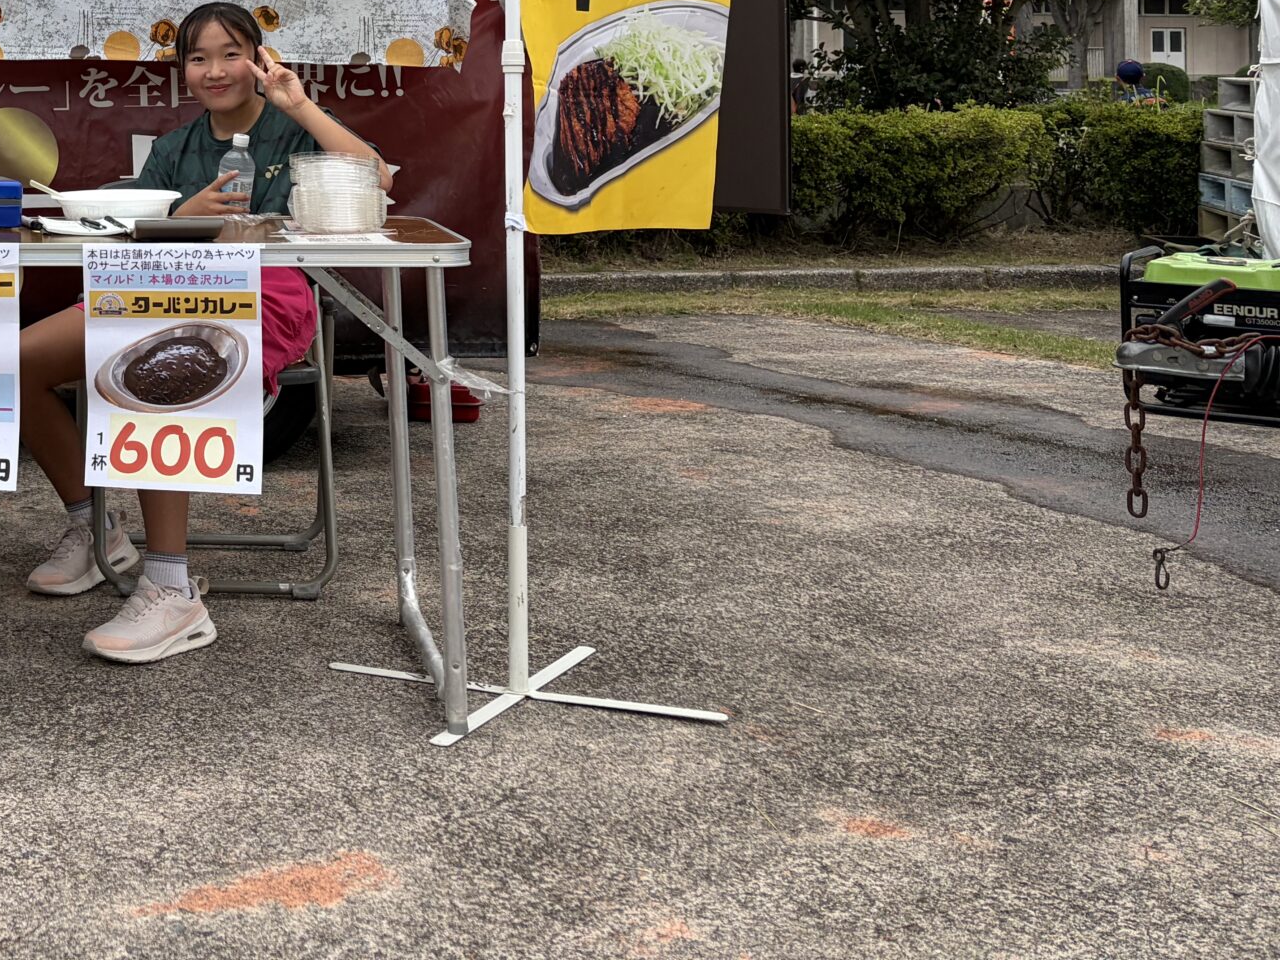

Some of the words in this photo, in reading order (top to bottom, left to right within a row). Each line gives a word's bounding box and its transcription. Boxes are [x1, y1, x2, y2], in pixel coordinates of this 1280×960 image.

[87, 249, 255, 260] 本日は店舗外イベントの為キャベツ
[87, 260, 206, 272] のサービス御座いません
[131, 296, 253, 315] ターバンカレー
[1213, 303, 1278, 319] EENOUR
